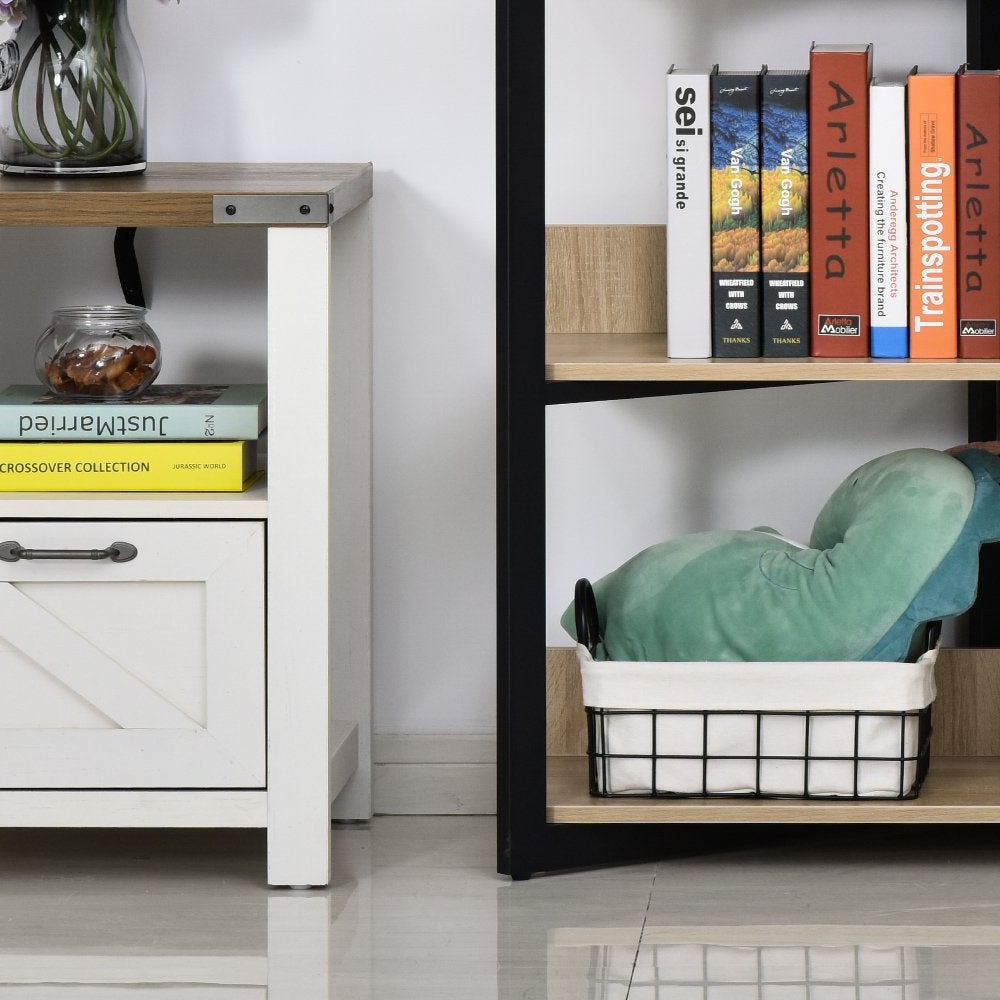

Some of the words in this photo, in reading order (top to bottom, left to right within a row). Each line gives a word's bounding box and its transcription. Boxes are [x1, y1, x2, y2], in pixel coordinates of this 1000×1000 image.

[674, 87, 703, 136] sei
[675, 139, 689, 153] si
[730, 148, 743, 174] Van
[781, 148, 793, 175] Van
[673, 156, 688, 210] grande
[728, 178, 743, 215] Gogh
[778, 179, 793, 216] Gogh
[825, 80, 856, 280] Arletta
[875, 171, 886, 216] Creating
[877, 219, 886, 236] the
[888, 190, 899, 241] Anderegg
[965, 123, 990, 294] Arletta
[877, 238, 886, 284] furniture
[914, 162, 951, 333] Trainspotting
[890, 244, 900, 298] Architects
[877, 286, 886, 317] brand
[19, 415, 169, 437] JustMarried
[75, 462, 150, 473] COLLECTION
